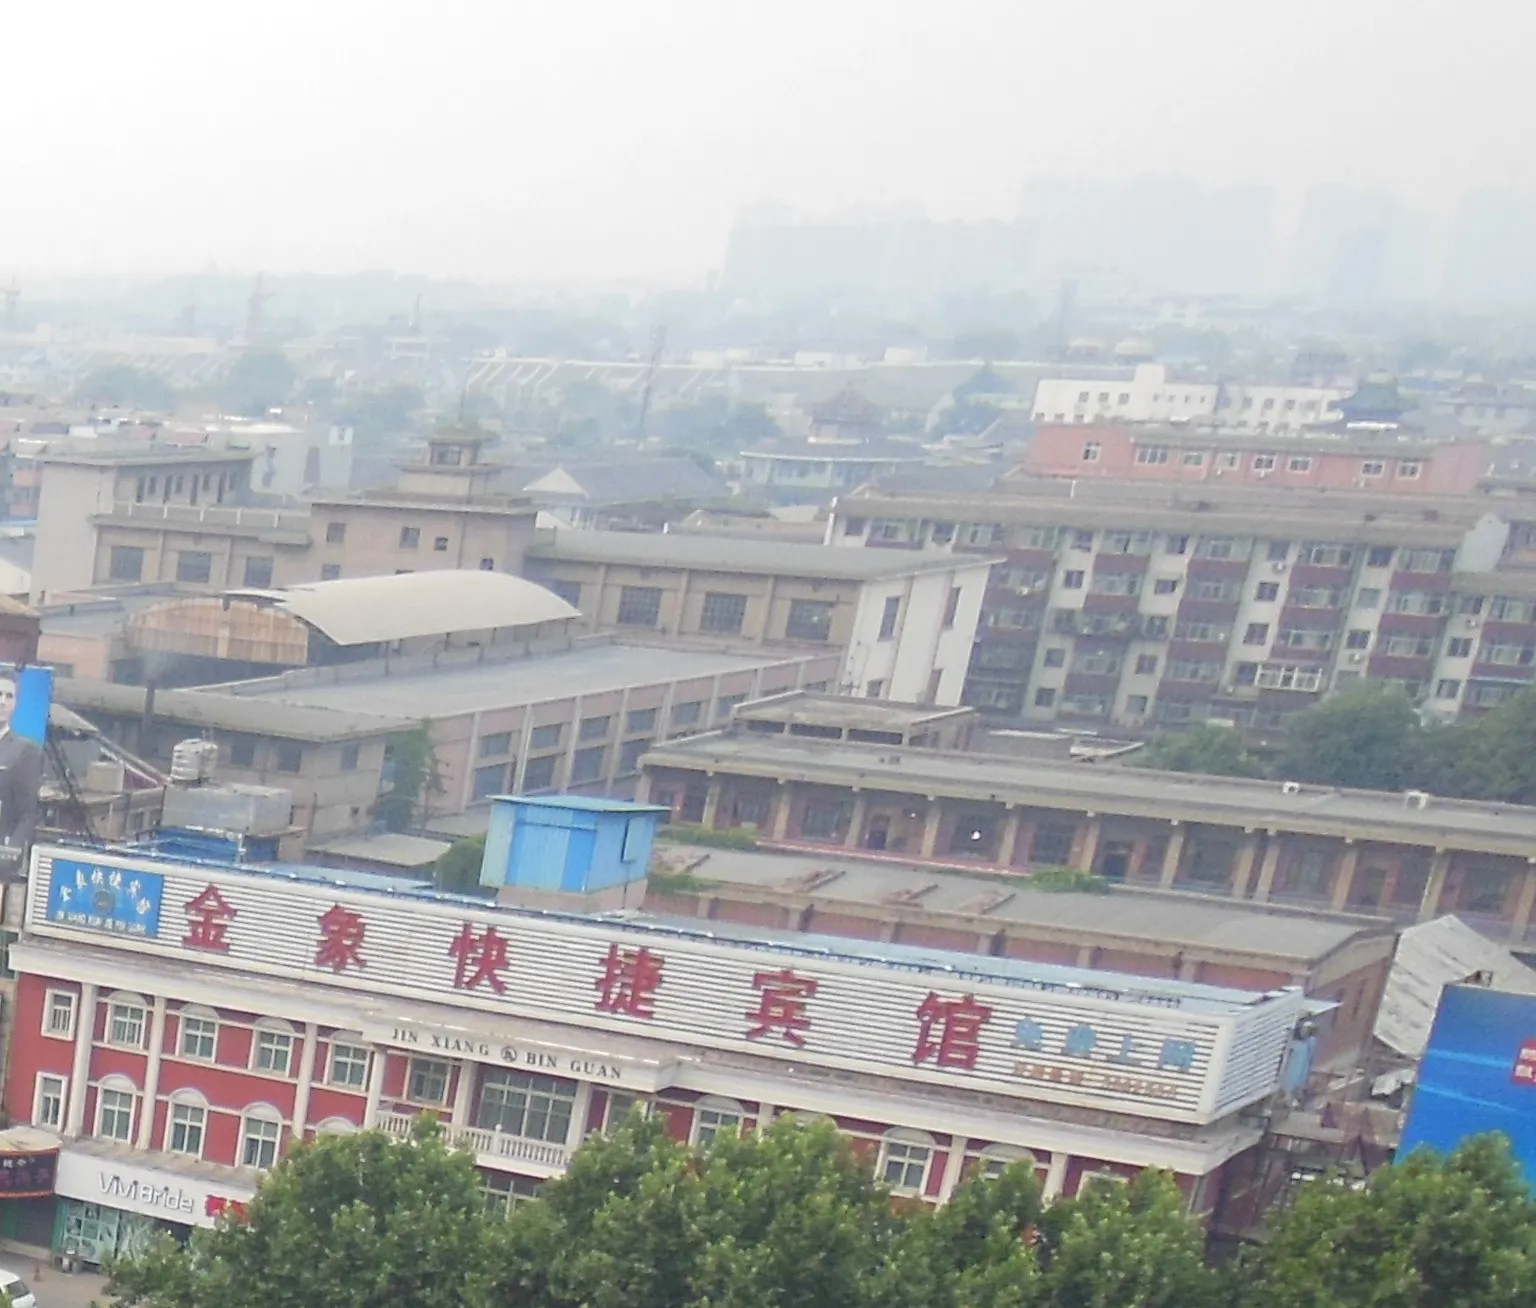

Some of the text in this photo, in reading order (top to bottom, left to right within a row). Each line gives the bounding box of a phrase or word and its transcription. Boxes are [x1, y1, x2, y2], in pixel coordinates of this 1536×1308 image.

[182, 883, 993, 1071] 金象快捷宾馆
[392, 1027, 622, 1078] JIN XIANG BIN GUAN
